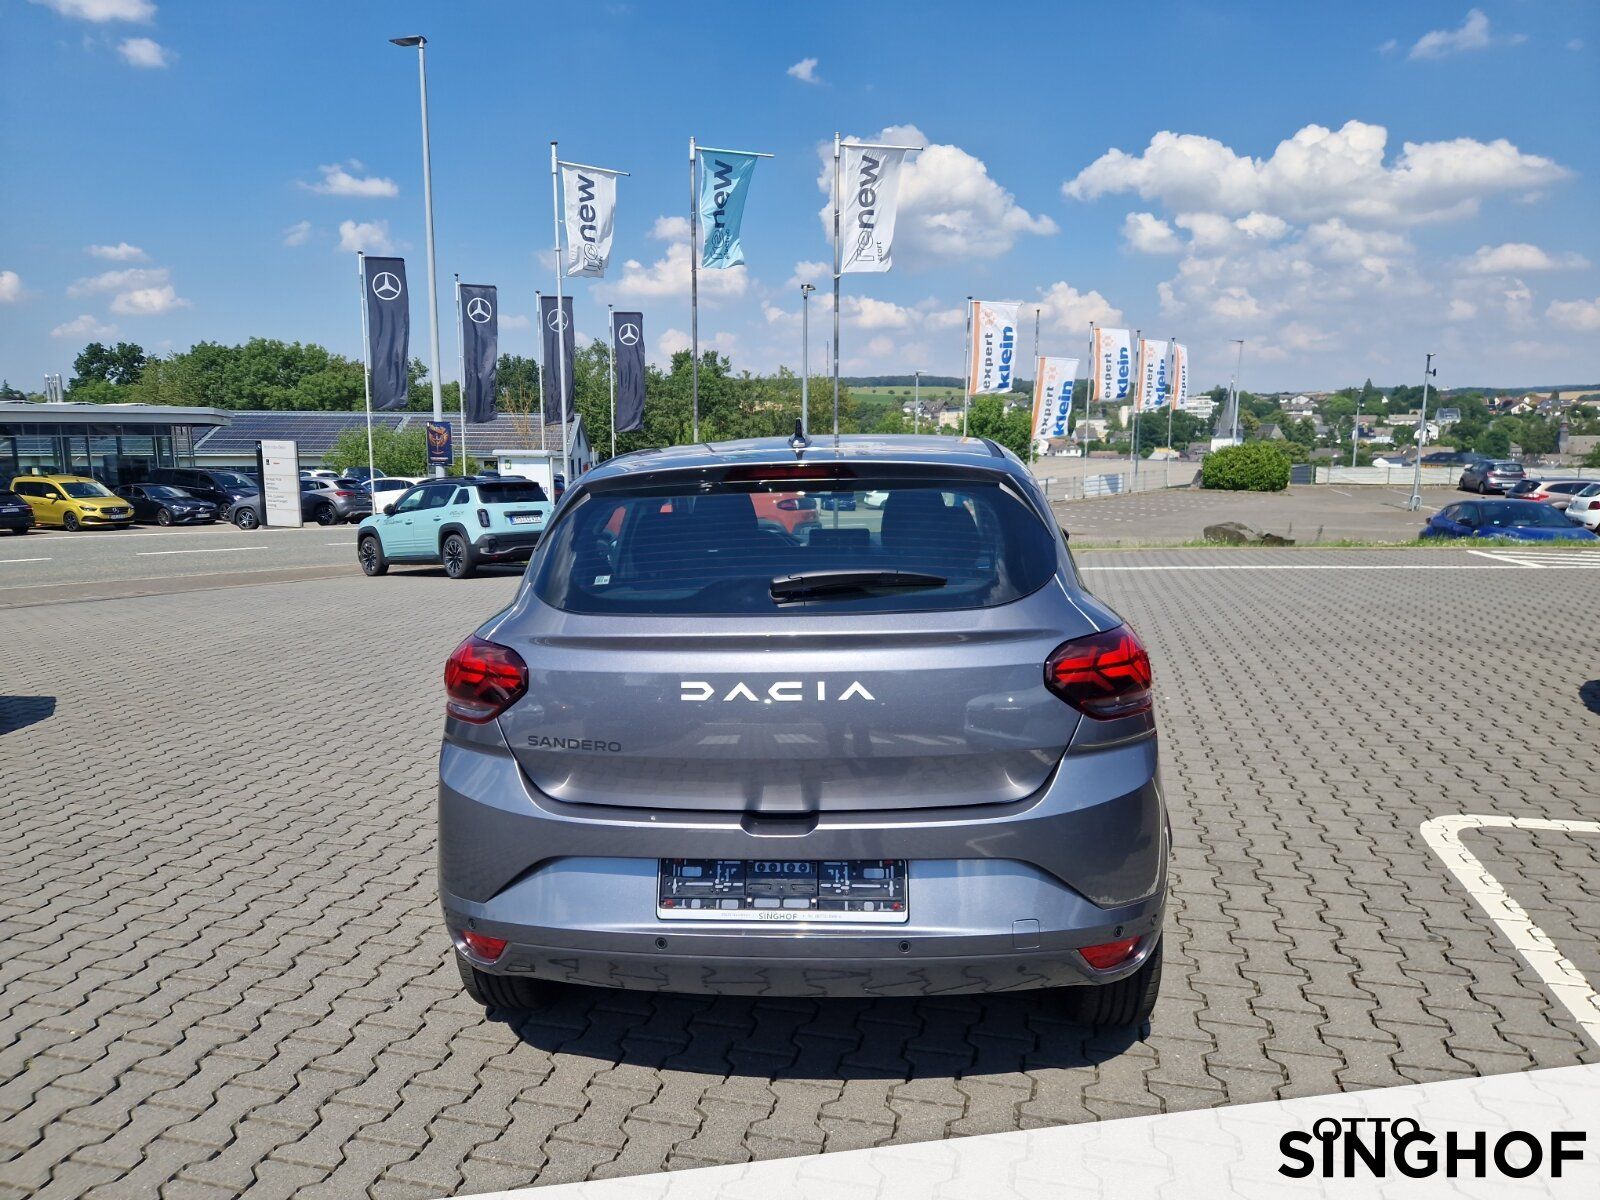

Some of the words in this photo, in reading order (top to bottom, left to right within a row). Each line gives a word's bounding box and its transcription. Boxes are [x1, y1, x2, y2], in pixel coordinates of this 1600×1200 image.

[710, 159, 733, 259] renew
[856, 155, 880, 261] renew
[983, 332, 994, 389] expert
[997, 326, 1014, 389] klein
[1116, 347, 1129, 399] klein
[1145, 362, 1154, 405] expert
[1040, 385, 1054, 435] expert
[1052, 380, 1073, 436] klein
[680, 681, 876, 702] DACIA
[528, 735, 622, 753] SANDERO
[758, 912, 798, 921] SINGHOF
